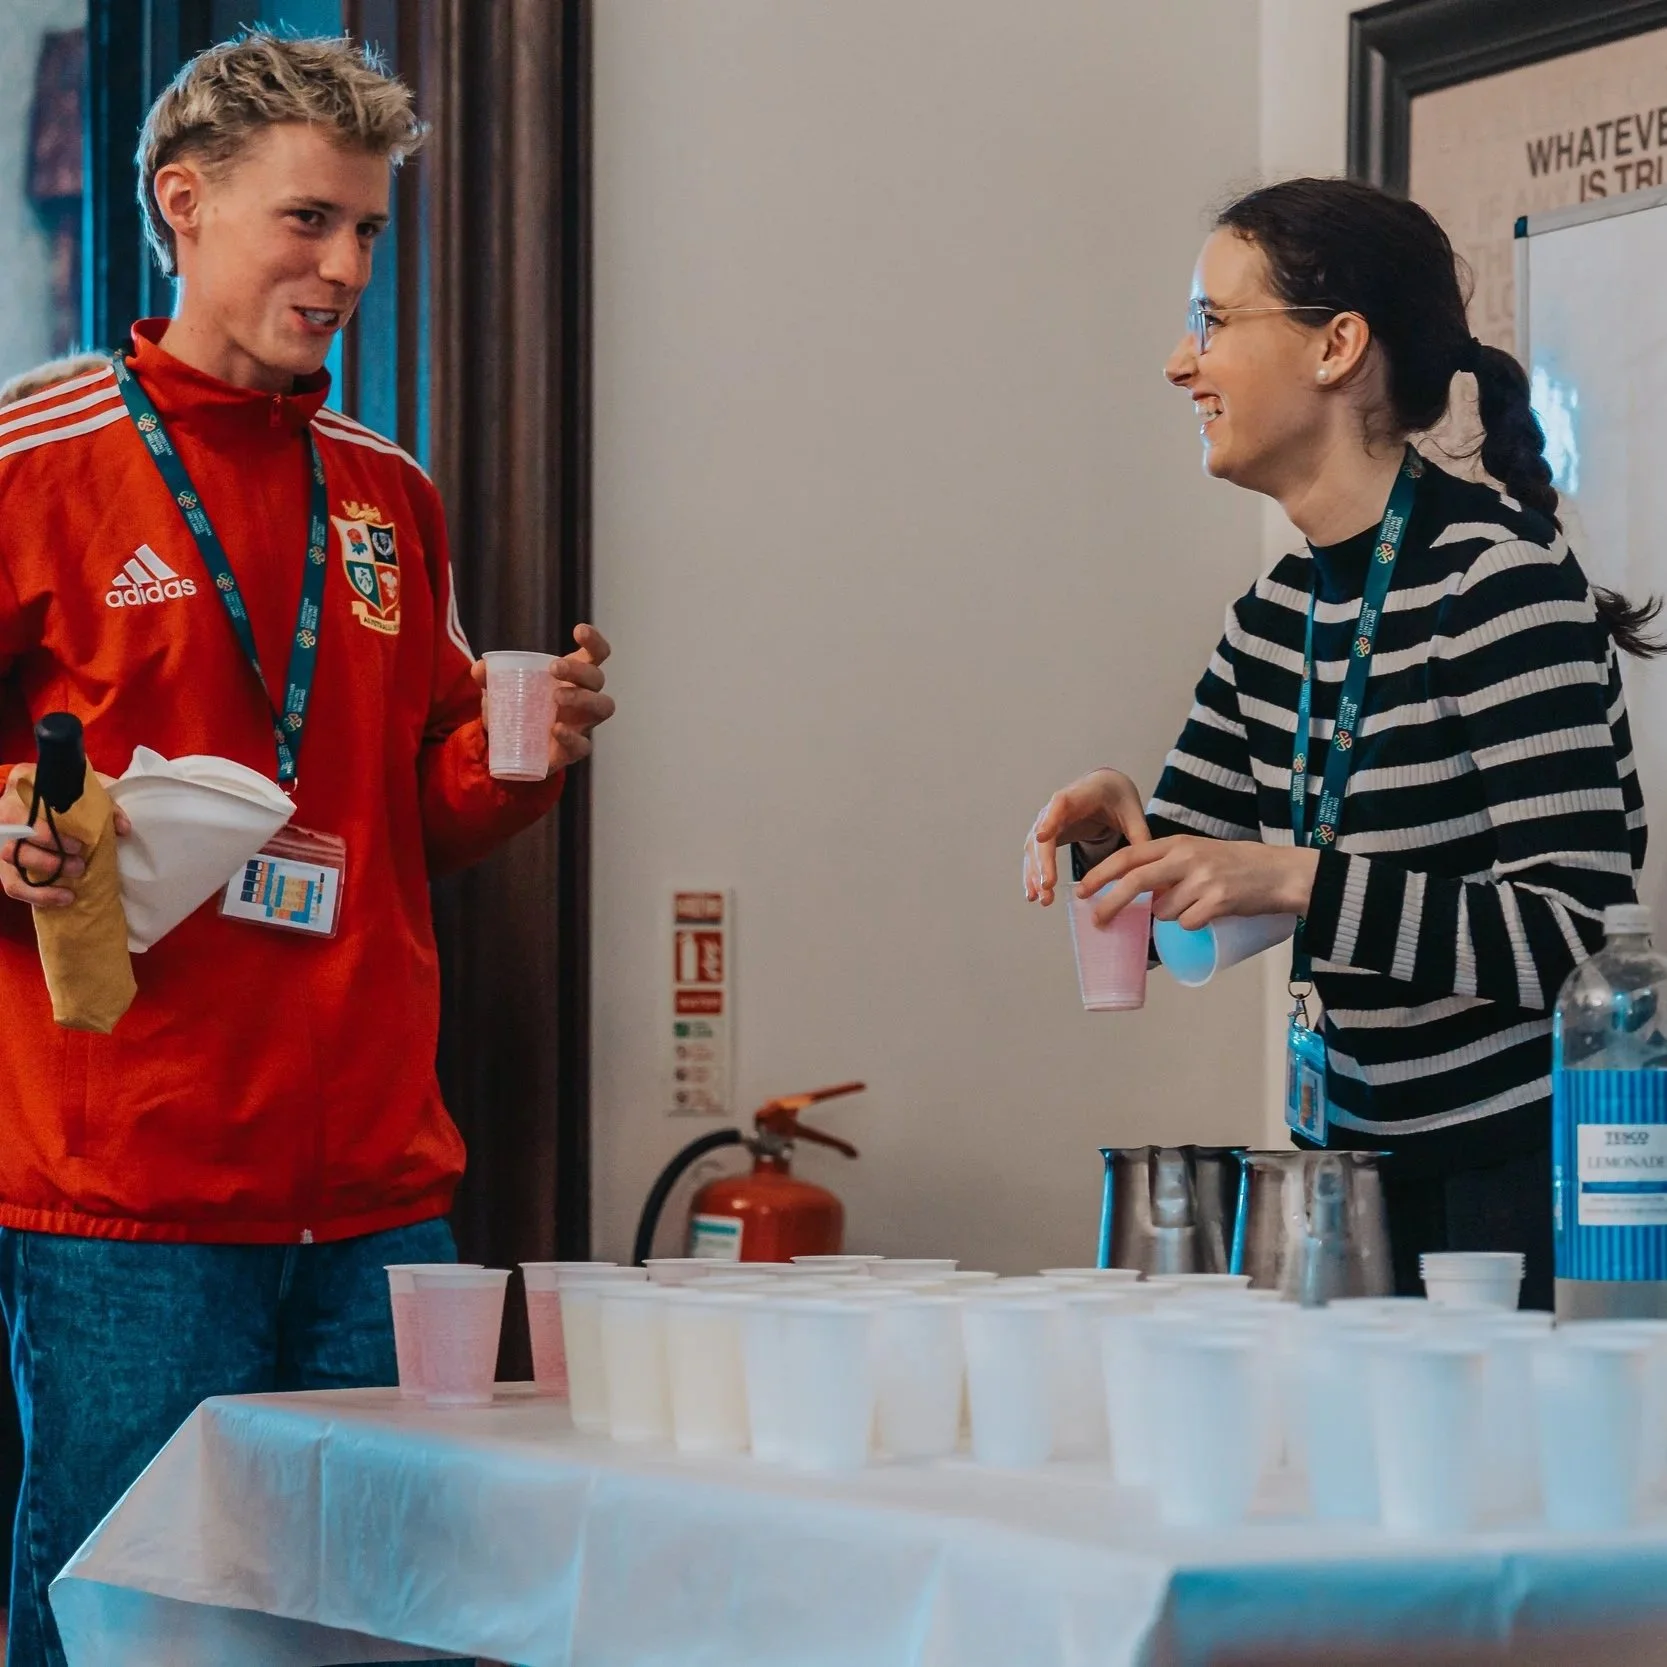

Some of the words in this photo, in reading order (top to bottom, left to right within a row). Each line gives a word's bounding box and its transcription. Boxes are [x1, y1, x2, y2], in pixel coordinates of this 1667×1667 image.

[1526, 107, 1667, 178] WHATEVE
[1579, 168, 1607, 202] IS
[146, 433, 160, 455] IRELAND
[150, 430, 165, 453] UNIONS
[155, 428, 173, 456] CHRISTIAN
[186, 510, 200, 534] IRELAND
[195, 507, 211, 536] CHRISTIAN
[1380, 509, 1393, 541] CHRISTIAN
[1384, 515, 1397, 542] UNIONS
[1390, 516, 1403, 543] IRELAND
[105, 577, 197, 608] adidas
[300, 597, 308, 627] CHRISTIAN
[1358, 602, 1369, 634] CHRISTIAN
[1362, 608, 1372, 635] UNIONS
[1366, 609, 1377, 636] IRELAND
[1337, 696, 1349, 728] CHRISTIAN
[1341, 702, 1352, 729] UNIONS
[1346, 703, 1358, 730] IRELAND
[1318, 790, 1329, 821] CHRISTIAN
[1323, 796, 1334, 823] UNIONS
[1329, 797, 1340, 824] IRELAND
[1604, 1131, 1650, 1143] TESCO
[1588, 1156, 1665, 1169] LEMONADE
